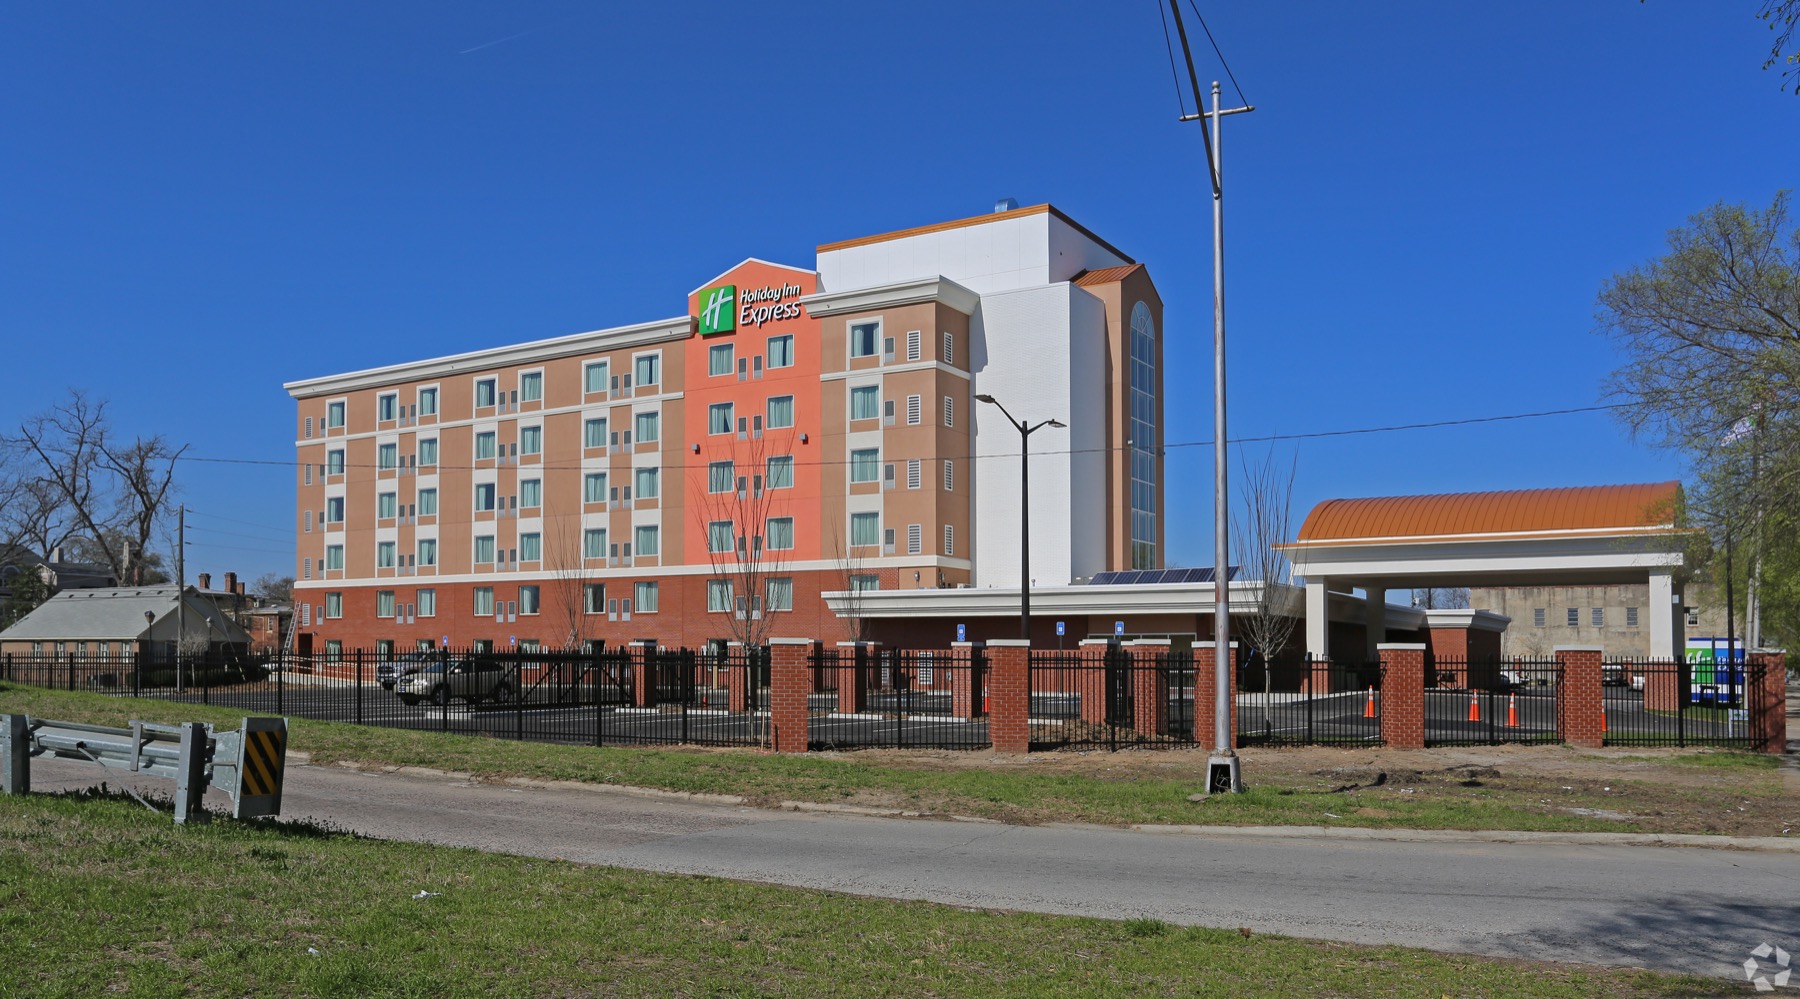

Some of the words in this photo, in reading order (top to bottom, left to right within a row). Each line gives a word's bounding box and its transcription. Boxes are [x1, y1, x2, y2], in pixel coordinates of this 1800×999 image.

[740, 285, 782, 303] Holiday
[782, 282, 800, 297] Inn
[740, 301, 800, 327] Express
